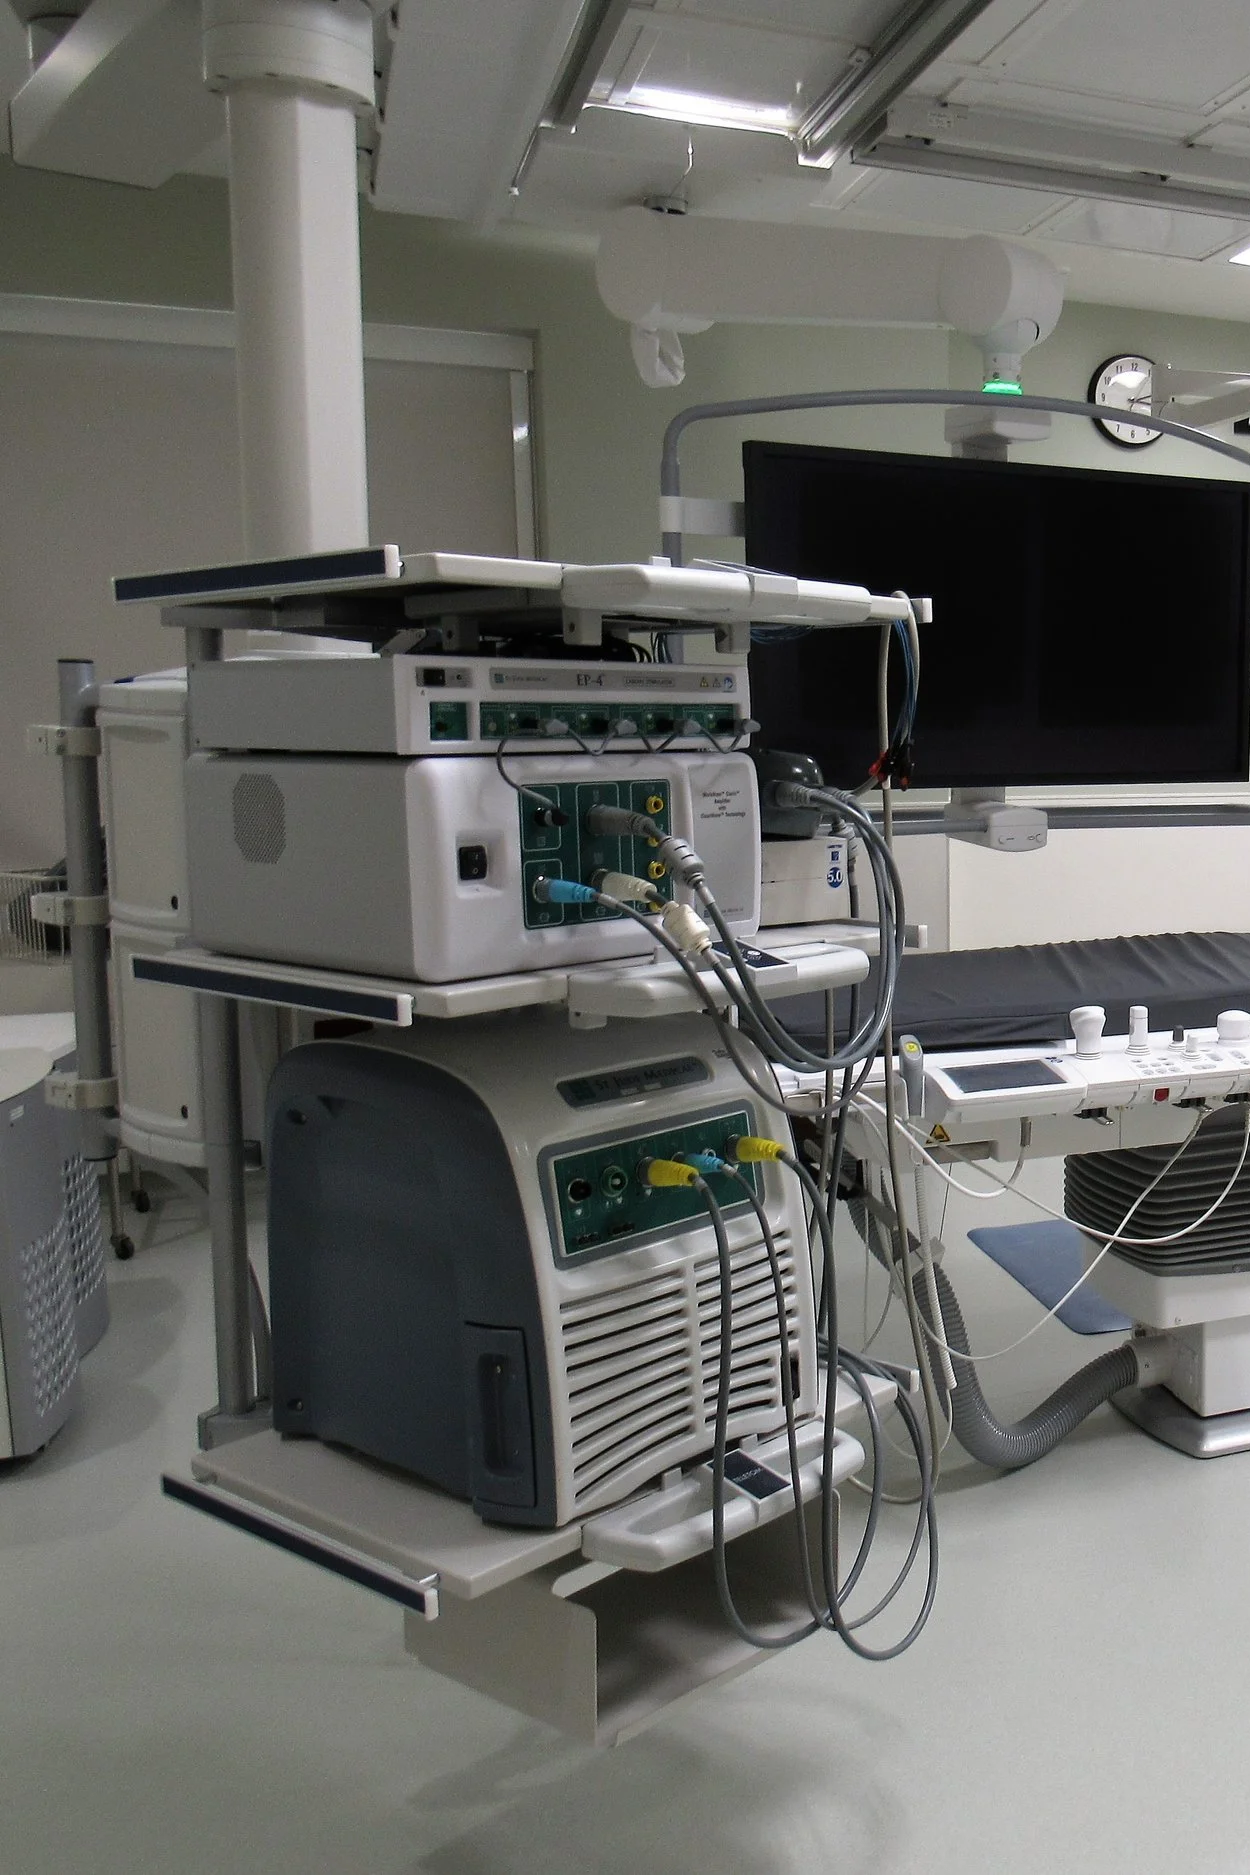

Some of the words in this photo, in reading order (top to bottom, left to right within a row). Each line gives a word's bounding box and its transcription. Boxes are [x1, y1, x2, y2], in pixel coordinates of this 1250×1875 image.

[1115, 365, 1123, 374] 11
[1131, 362, 1139, 372] 12
[1101, 392, 1106, 402] 9
[1116, 424, 1120, 433] 7
[1130, 429, 1136, 439] 6
[827, 870, 843, 883] 5.0
